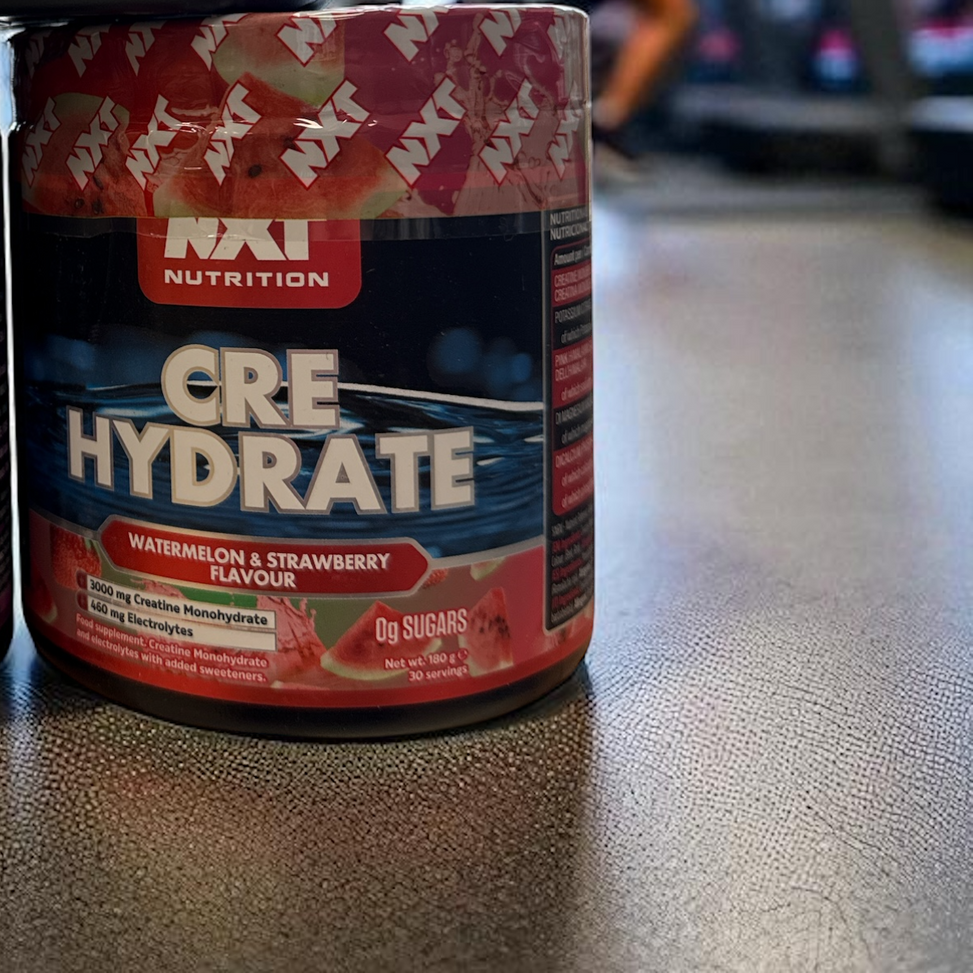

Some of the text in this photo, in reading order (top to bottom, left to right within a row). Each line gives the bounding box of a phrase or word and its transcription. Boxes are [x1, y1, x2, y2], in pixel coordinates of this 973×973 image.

[22, 96, 62, 187] NXT
[66, 96, 120, 191] NXT
[125, 94, 182, 191] NXT
[204, 80, 264, 186] NXT
[279, 78, 371, 190] NXT
[384, 76, 467, 189] NXT
[478, 78, 540, 187] NXT
[164, 269, 329, 287] NUTRITION
[160, 343, 340, 428] CRE
[66, 405, 475, 515] HYDRATE
[128, 532, 390, 570] WATERMELON & STRAWBERRY
[210, 564, 296, 588] FLAVOUR
[89, 579, 267, 625] 3000 mg Creatine Monohydrate
[90, 599, 193, 637] 460 mg Electrolytes
[375, 608, 467, 644] 0g SUGARS
[76, 613, 267, 668] Food supplement. Creatine Monohydrate
[77, 628, 267, 682] and electrolytes with added sweeteners.
[384, 652, 456, 669] Net wt. 180 g
[408, 665, 467, 681] 30 servings
